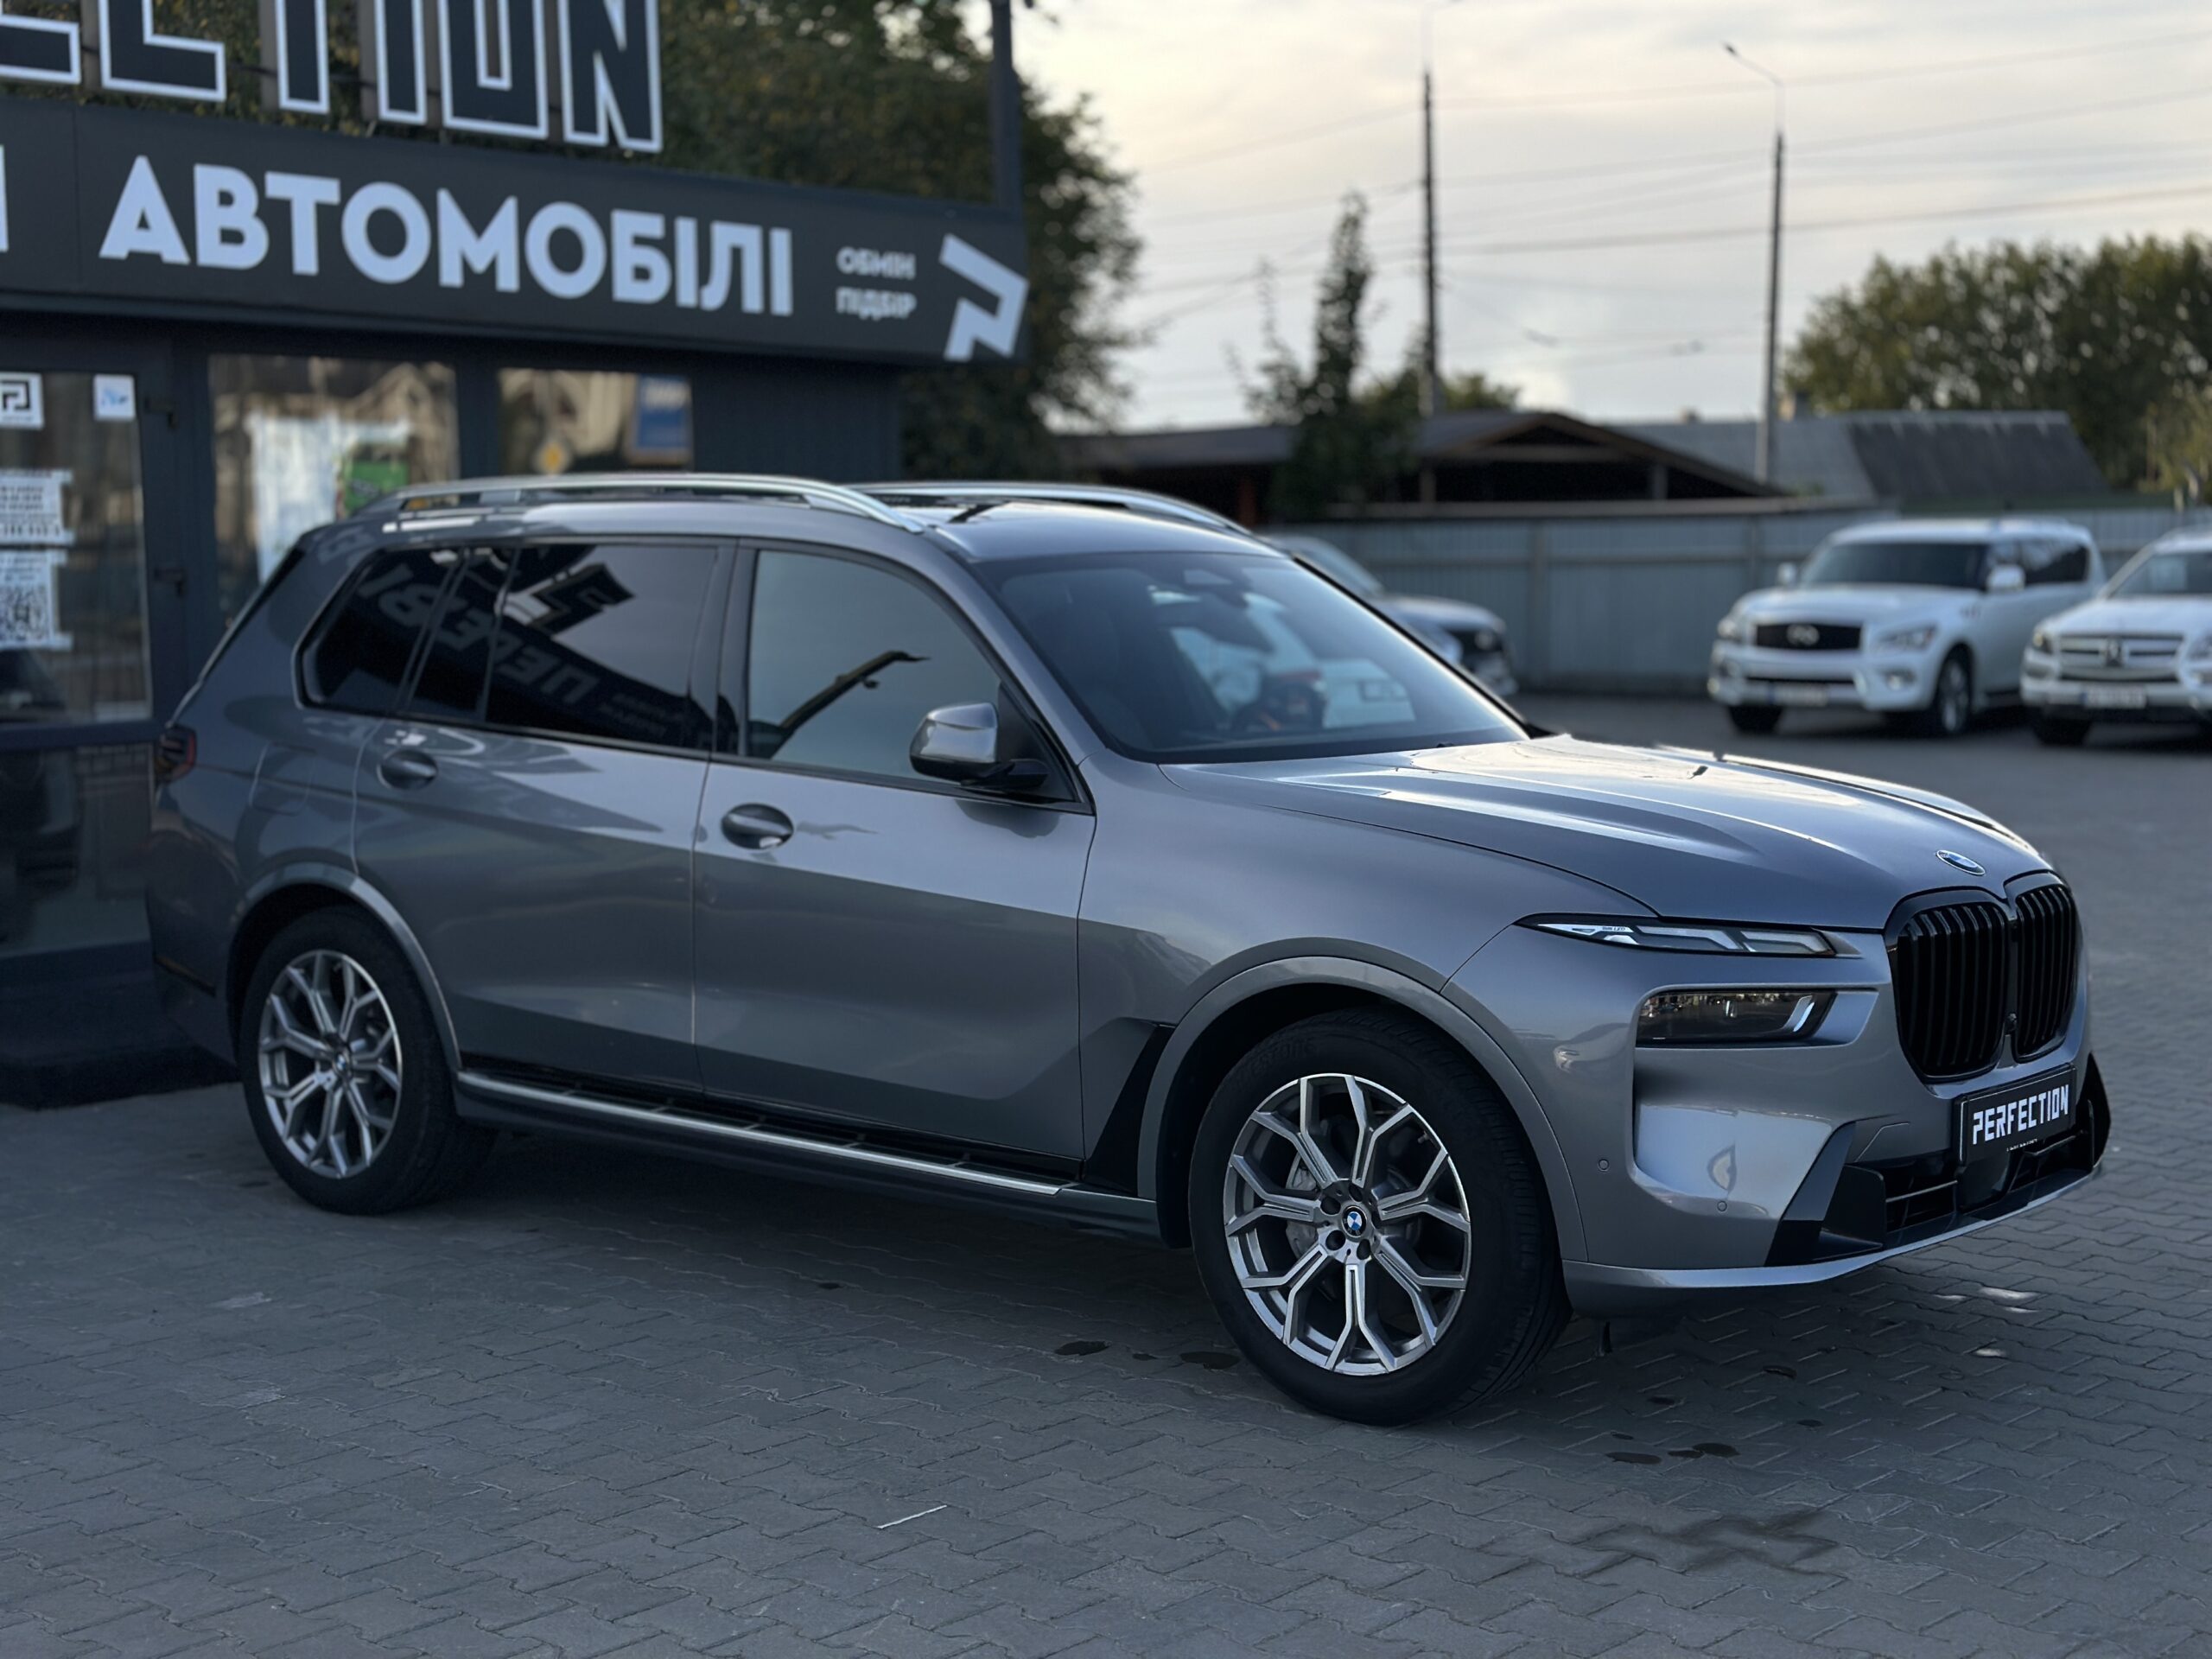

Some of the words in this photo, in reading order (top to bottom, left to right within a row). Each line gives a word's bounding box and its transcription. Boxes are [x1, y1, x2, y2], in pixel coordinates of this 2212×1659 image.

[99, 155, 793, 316] АВТОМОБІЛІ
[836, 245, 917, 280] ОБМІН
[835, 286, 917, 321] ПІДБІР
[1972, 1084, 2070, 1146] PERFECTION
